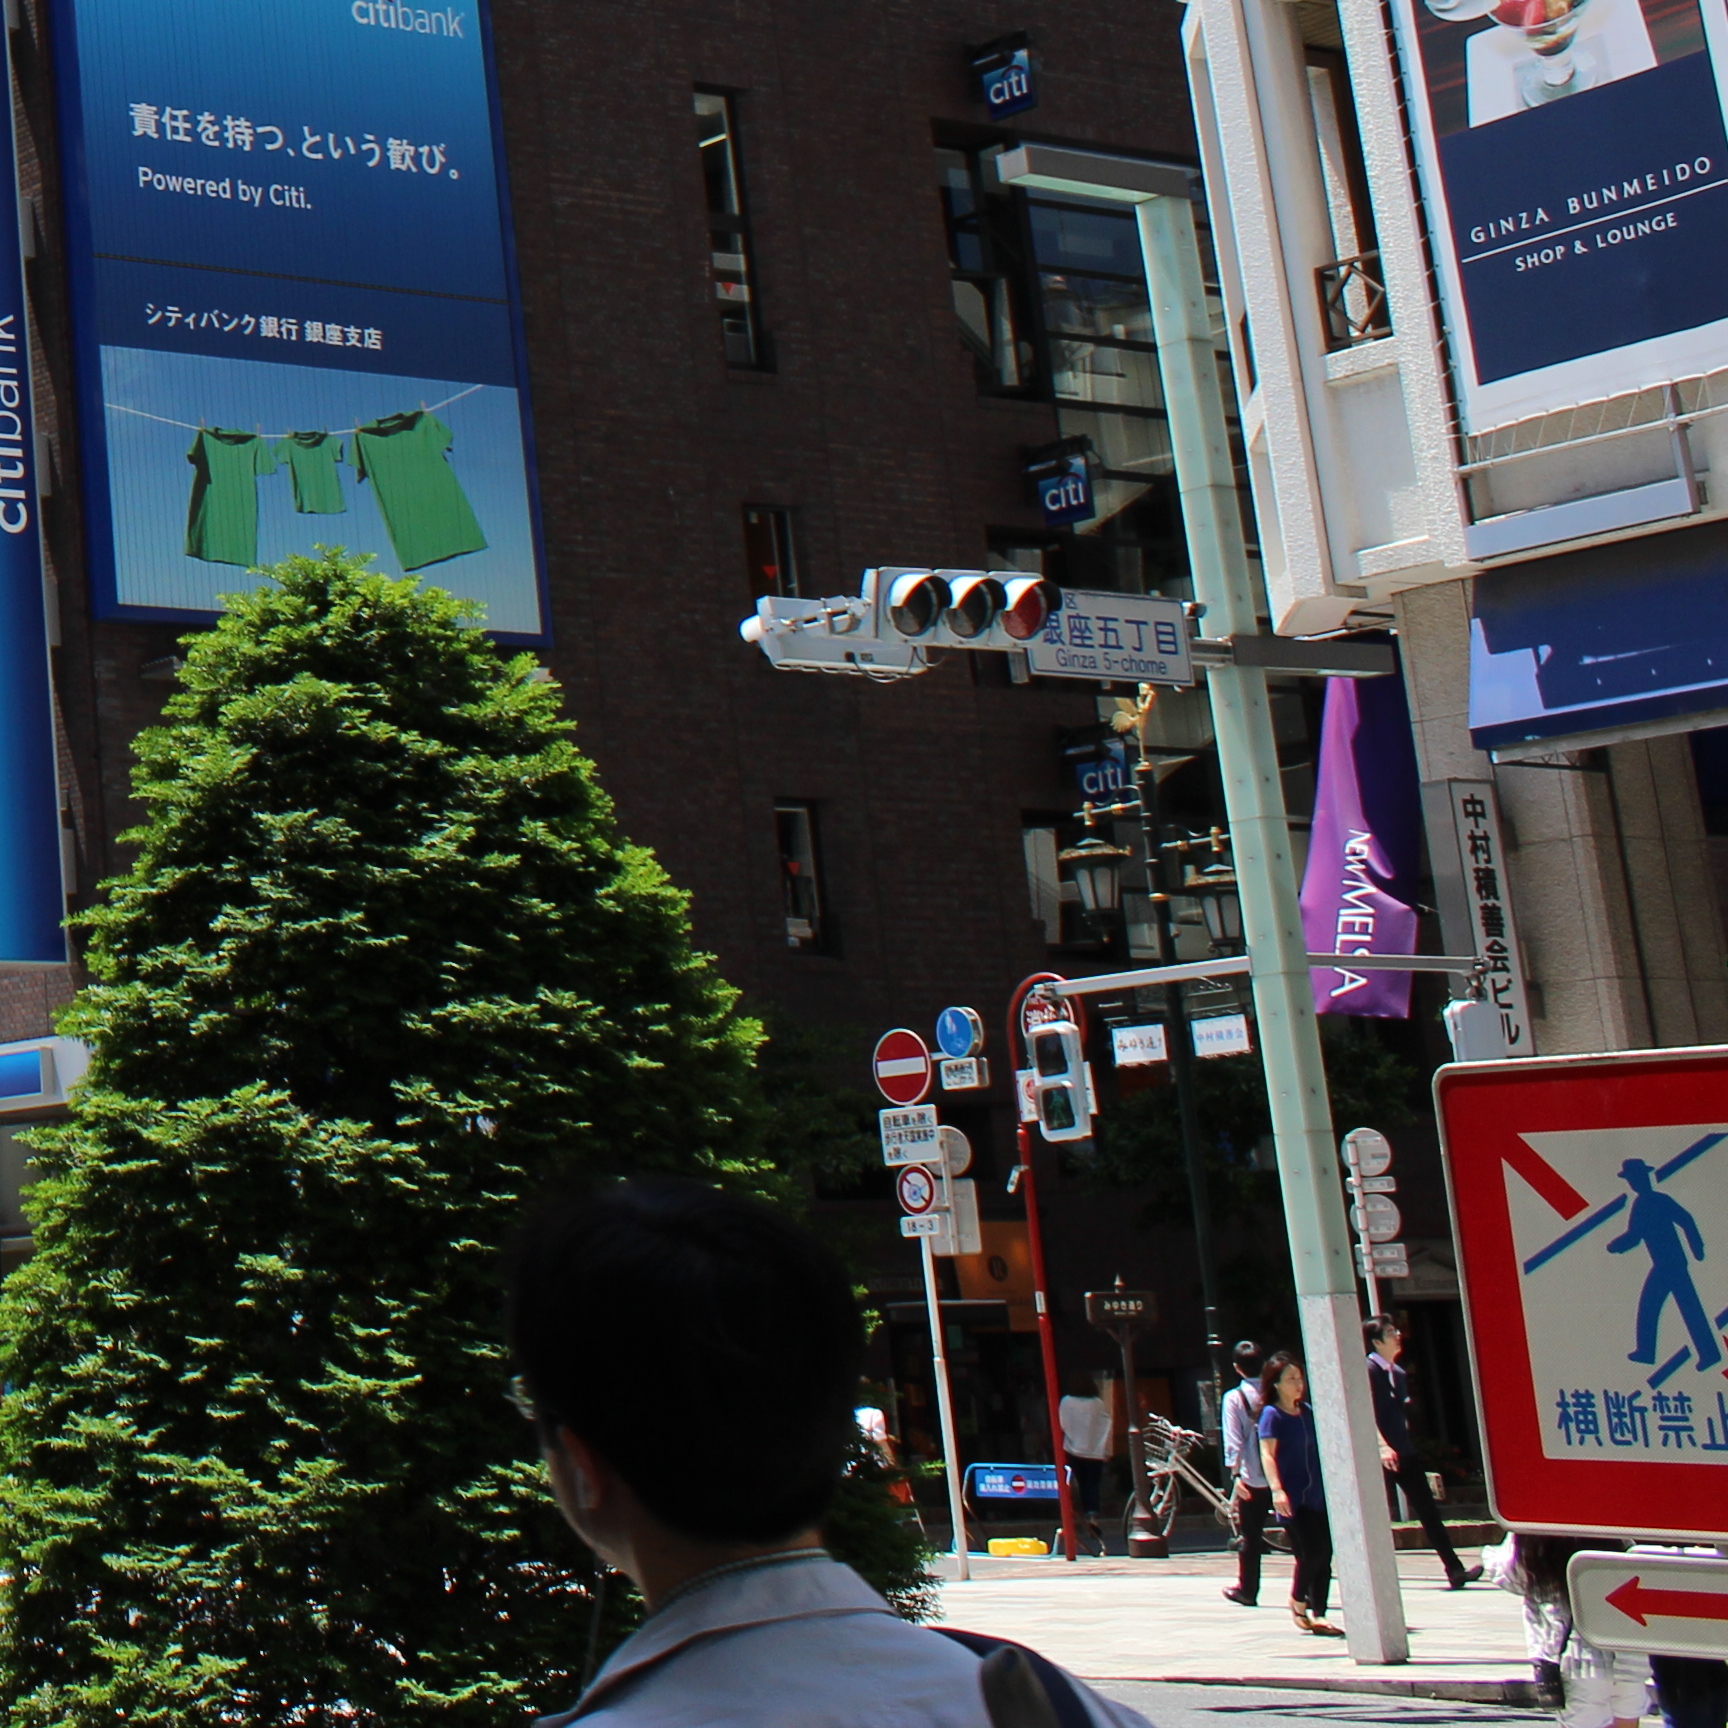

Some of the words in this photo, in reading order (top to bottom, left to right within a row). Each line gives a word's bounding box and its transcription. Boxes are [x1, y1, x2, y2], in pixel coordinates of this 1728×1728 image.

[989, 66, 1028, 107] citi
[129, 101, 461, 180] 責任を持つ、という歓び。
[137, 166, 231, 202] Powered
[237, 175, 262, 207] by
[268, 181, 312, 210] Citi.
[1469, 206, 1550, 246] GINZA
[1566, 155, 1712, 216] BUNMEIDO
[1514, 245, 1566, 274] SHOP
[1572, 239, 1588, 256] &
[1595, 211, 1678, 250] LOUNGE
[144, 301, 299, 342] シティバンク銀行
[304, 319, 382, 351] 銀座支店
[1044, 471, 1085, 513] citi
[1055, 650, 1097, 670] Ginza
[1102, 654, 1167, 677] 5-chome
[1081, 758, 1124, 795] citi
[1345, 827, 1373, 875] NEW
[1461, 793, 1520, 1047] 中村積善会ビル
[1103, 1299, 1143, 1310] みゆき通り
